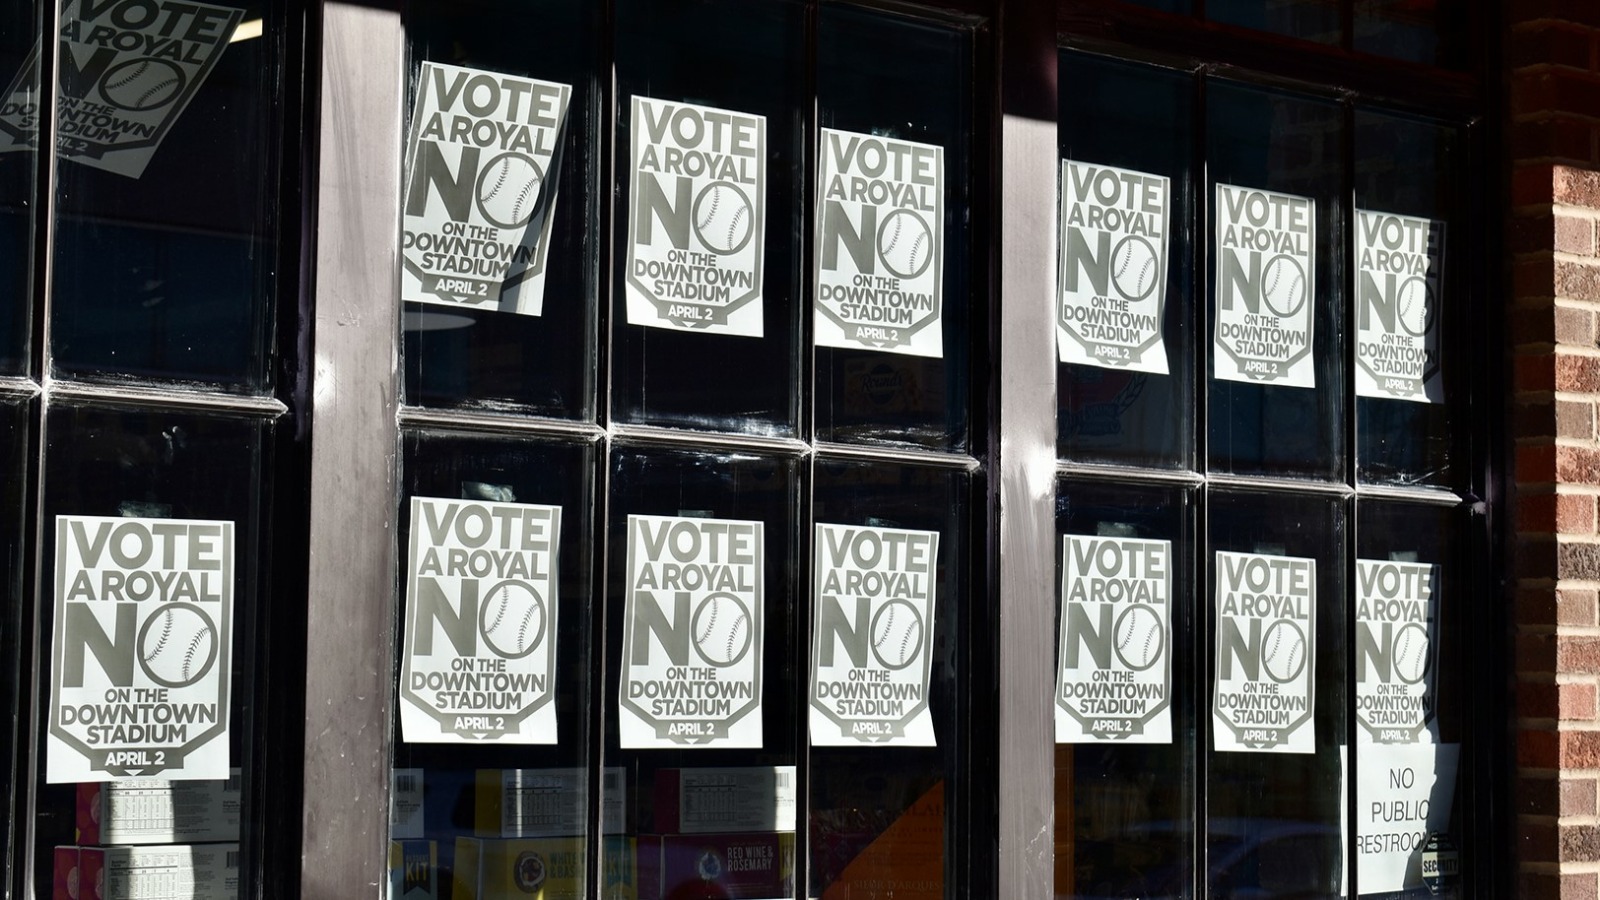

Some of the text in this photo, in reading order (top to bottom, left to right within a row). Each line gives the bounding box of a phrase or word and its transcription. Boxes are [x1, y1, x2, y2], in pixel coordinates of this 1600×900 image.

[79, 0, 231, 44] VOTE
[85, 26, 204, 65] ROYAL
[82, 100, 116, 116] THE
[432, 68, 560, 128] VOTE
[1, 103, 156, 138] DONTOWN
[18, 116, 121, 143] SDIUM
[641, 101, 756, 157] VOTE
[421, 112, 552, 156] A ROYAL
[639, 144, 755, 184] A ROYAL
[830, 133, 934, 185] VOTE
[826, 174, 934, 211] A ROYAL
[1069, 164, 1161, 213] VOTE
[1068, 203, 1160, 238] A ROYAL
[1223, 188, 1307, 233] VOTE
[442, 222, 498, 241] ON THE
[1223, 225, 1307, 256] A ROYAL
[1360, 213, 1438, 254] VOTE
[403, 231, 536, 264] DOWNTOWN
[421, 253, 509, 279] STADIUM
[668, 250, 716, 267] ON THE
[1360, 248, 1437, 278] A ROYAL
[635, 259, 752, 289] DOWNTOWN
[853, 274, 899, 290] ON THE
[435, 278, 487, 296] APRIL 2
[654, 282, 729, 302] STADIUM
[820, 284, 932, 311] DOWNTOWN
[1091, 296, 1128, 312] ON THE
[668, 304, 712, 320] APRIL 2
[839, 303, 912, 324] STADIUM
[1063, 304, 1156, 332] DOWNTOWN
[1244, 314, 1279, 327] ON THE
[856, 326, 898, 341] APRIL 2
[1081, 322, 1140, 344] STADIUM
[1221, 323, 1305, 346] DOWNTOWN
[1382, 333, 1413, 347] ON THE
[1094, 345, 1129, 359] APRIL 2
[1235, 339, 1289, 358] STADIUM
[1359, 342, 1435, 367] DOWNTOWN
[1245, 362, 1277, 373] APRIL 2
[1373, 359, 1422, 376] STADIUM
[1385, 378, 1413, 390] APRIL 2
[422, 502, 550, 551] VOTE
[70, 521, 221, 570] VOTE
[638, 519, 753, 564] VOTE
[824, 528, 928, 573] VOTE
[418, 547, 548, 581] A ROYAL
[1072, 539, 1164, 580] VOTE
[67, 569, 220, 602] A ROYAL
[636, 563, 753, 592] A ROYAL
[823, 569, 926, 599] A ROYAL
[1224, 556, 1308, 596] VOTE
[1357, 562, 1434, 600] VOTE
[1069, 577, 1164, 604] A ROYAL
[1222, 592, 1308, 620] A ROYAL
[1357, 598, 1433, 623] A ROYAL
[452, 658, 506, 672] ON THE
[666, 668, 716, 680] ON THE
[411, 672, 545, 693] DOWNTOWN
[848, 669, 890, 682] ON THE
[1092, 670, 1134, 683] ON THE
[105, 689, 168, 702] ON THE
[629, 680, 752, 699] DOWNTOWN
[818, 681, 921, 701] DOWNTOWN
[1063, 682, 1163, 700] DOWNTOWN
[1243, 682, 1278, 694] ON THE
[1377, 684, 1408, 695] ON THE
[435, 691, 521, 710] STADIUM
[651, 699, 730, 716] STADIUM
[836, 699, 903, 717] STADIUM
[1080, 698, 1145, 714] STADIUM
[1219, 693, 1306, 710] DOWNTOWN
[1356, 694, 1431, 710] DOWNTOWN
[60, 703, 216, 726] DOWNTOWN
[454, 717, 504, 730] APRIL 2
[1233, 710, 1289, 725] STADIUM
[1369, 710, 1417, 724] STADIUM
[87, 725, 187, 744] STADIUM
[668, 723, 714, 736] APRIL 2
[852, 720, 892, 734] APRIL 2
[1092, 720, 1132, 732] APRIL 2
[1243, 730, 1277, 741] APRIL 2
[1381, 729, 1410, 740] APRIL 2
[105, 752, 164, 766] APRIL 2
[1390, 768, 1414, 789] NO
[1372, 800, 1430, 822] PUBLIC
[728, 846, 773, 858] RED WINE &
[406, 862, 429, 881] KIT
[728, 858, 772, 871] ROSEMARY
